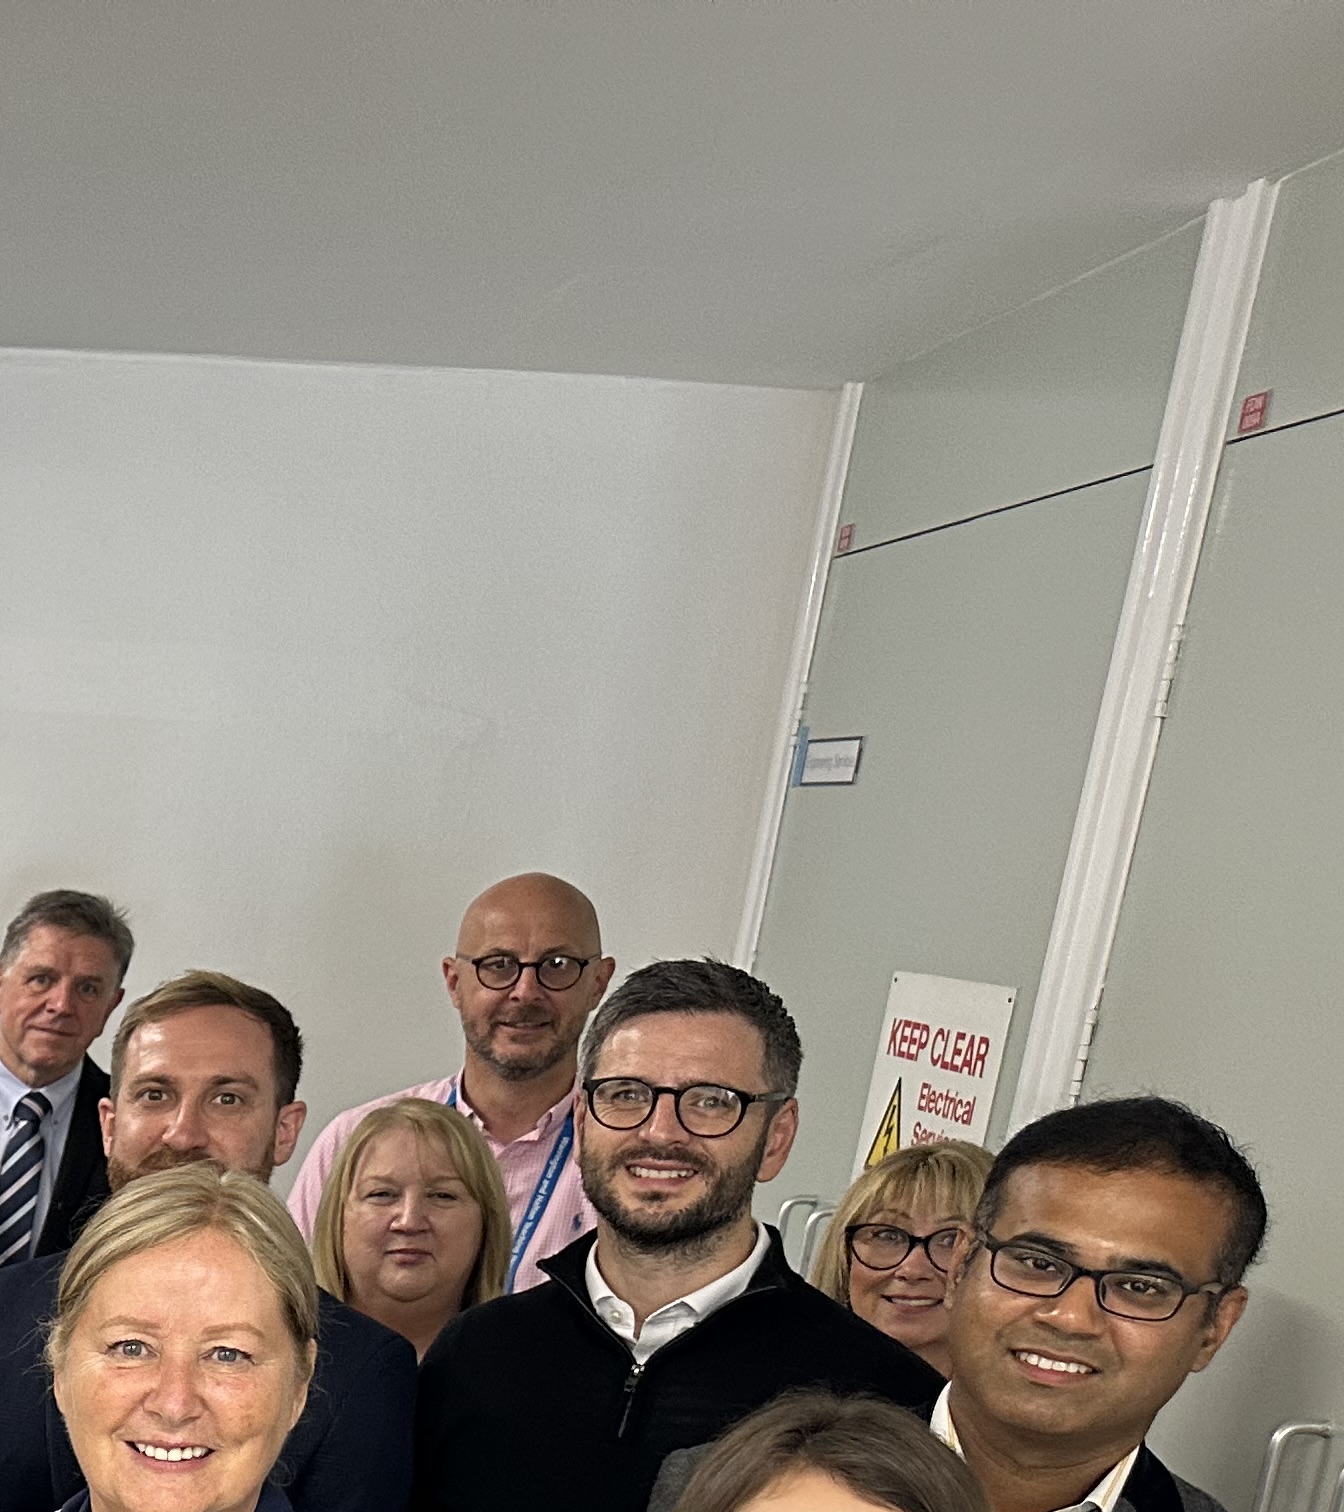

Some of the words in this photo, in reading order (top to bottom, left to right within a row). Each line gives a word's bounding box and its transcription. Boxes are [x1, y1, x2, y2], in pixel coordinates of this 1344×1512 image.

[886, 1017, 931, 1062] KEEP
[930, 1027, 990, 1079] CLEAR
[917, 1082, 976, 1127] Electrical
